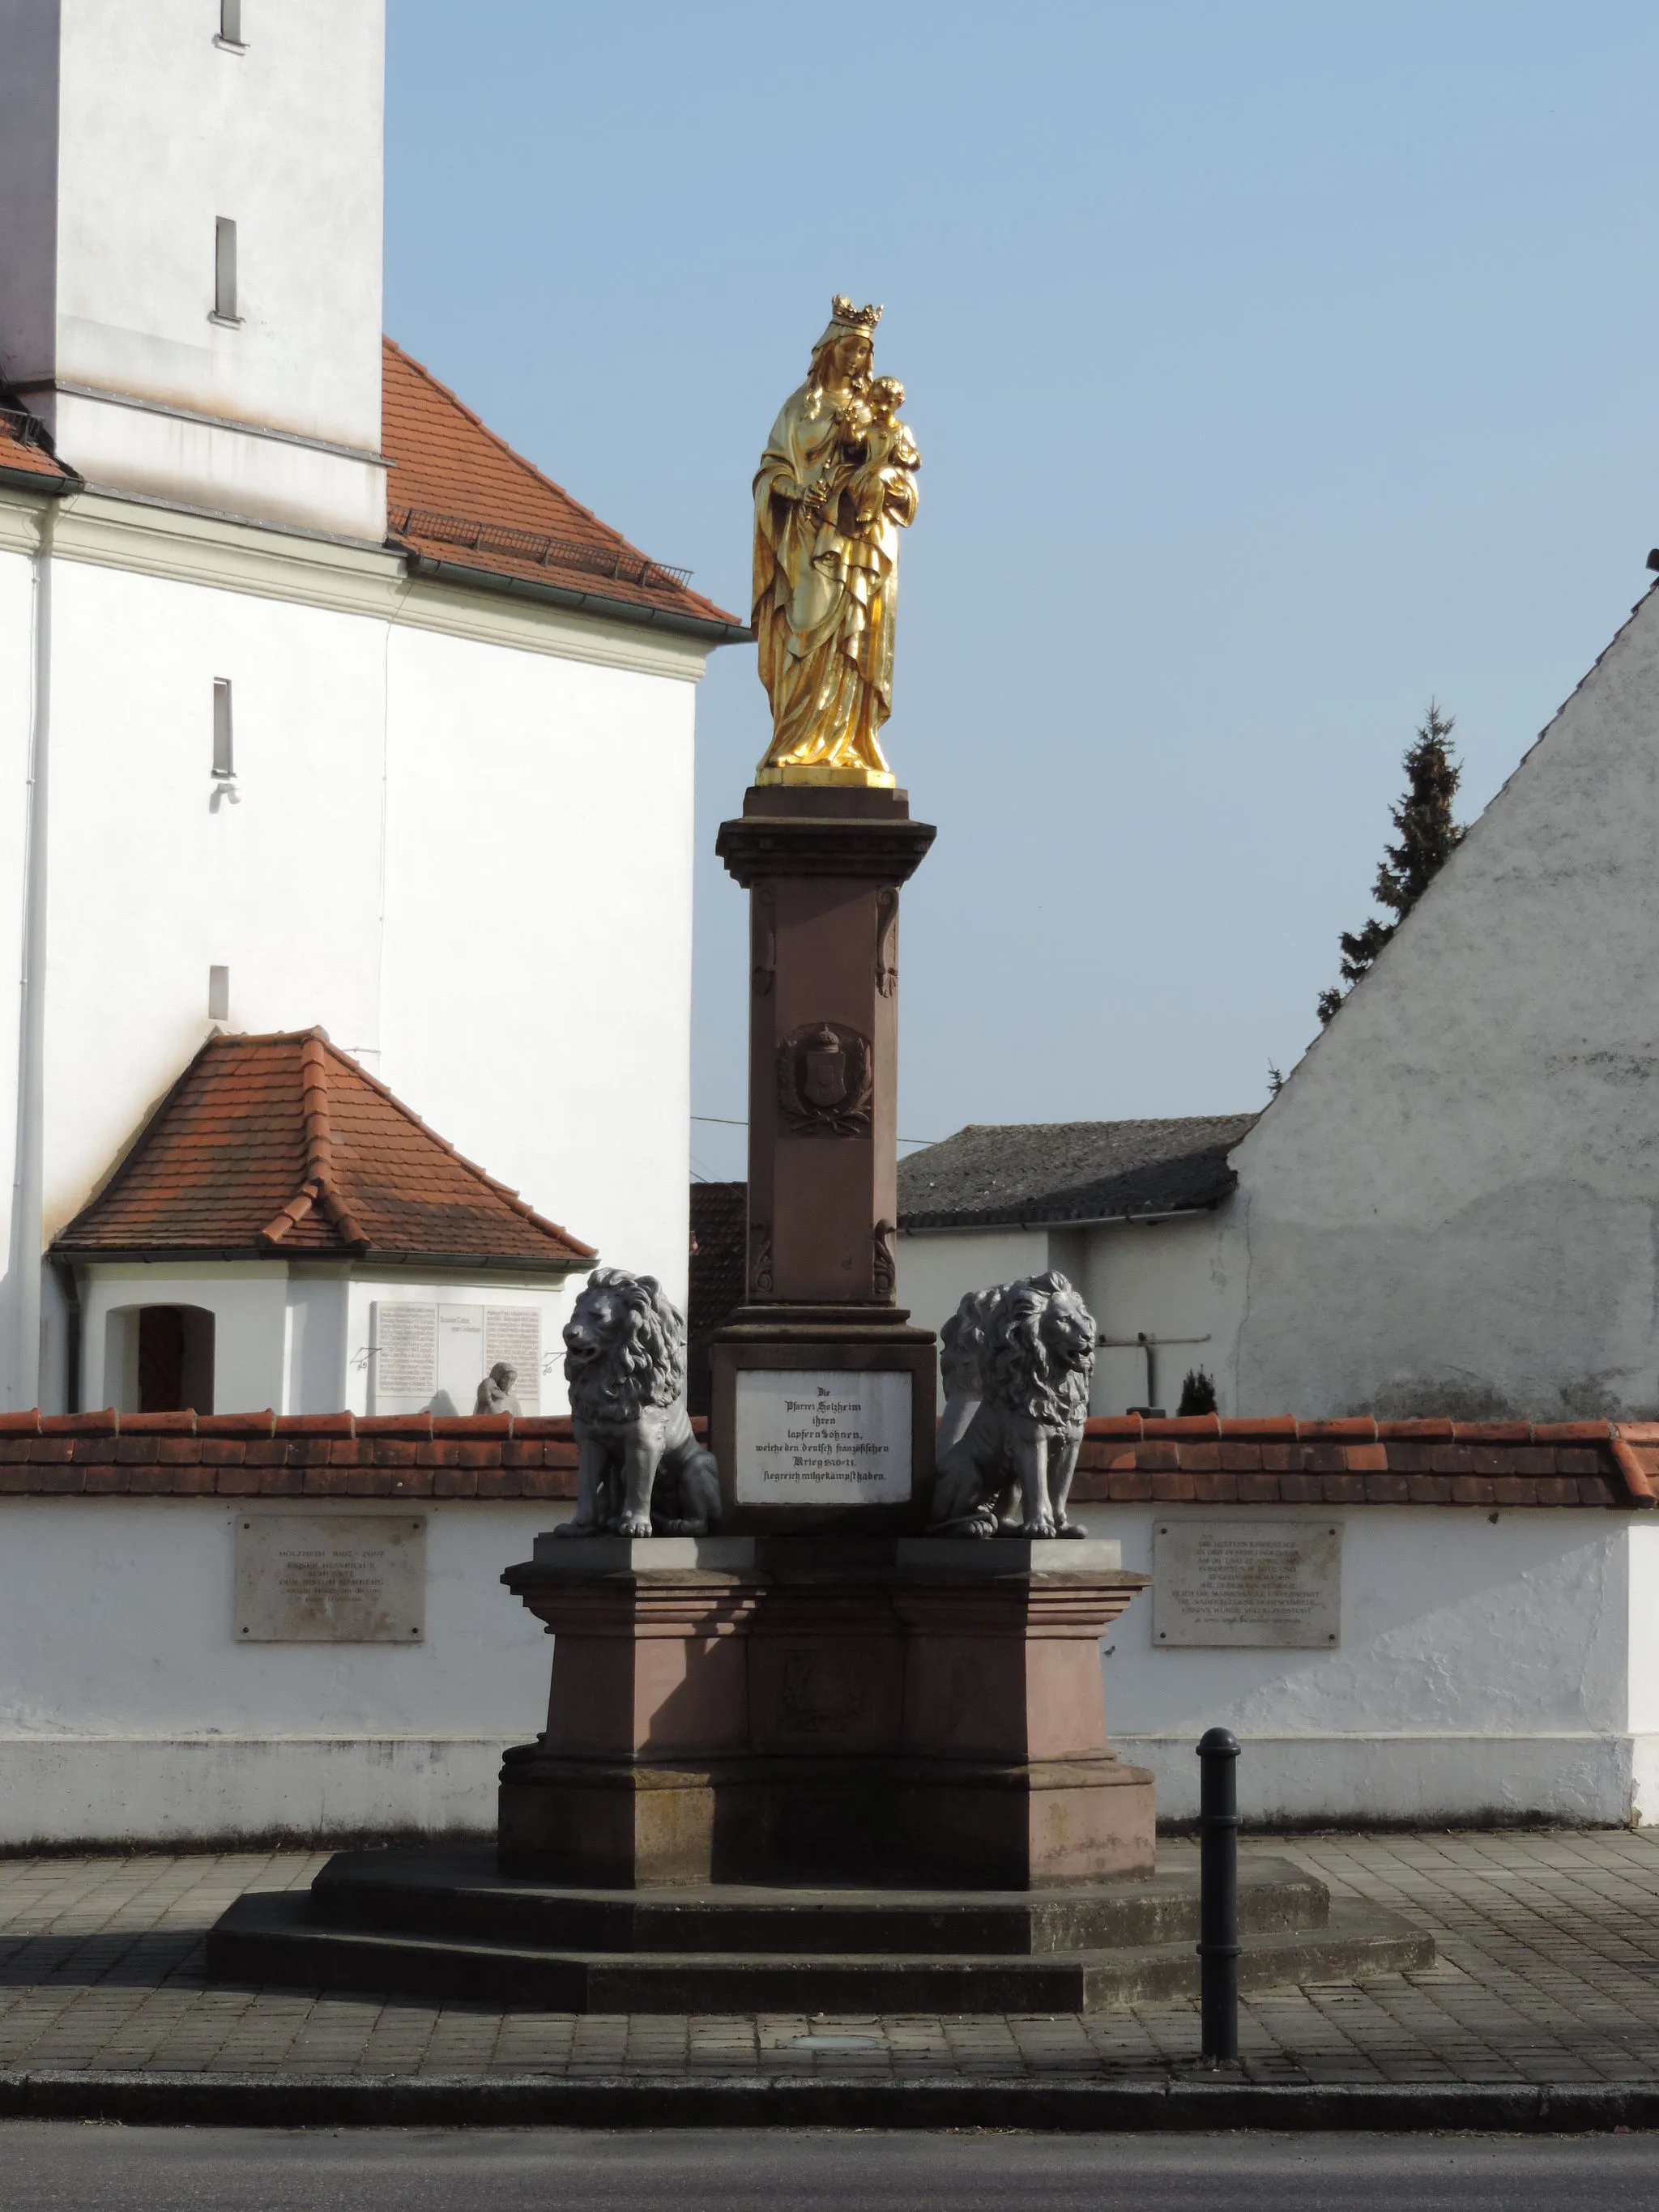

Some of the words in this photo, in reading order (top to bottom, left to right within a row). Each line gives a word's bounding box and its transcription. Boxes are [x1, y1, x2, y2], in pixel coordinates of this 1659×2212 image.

[817, 1386, 831, 1397] Die
[784, 1400, 816, 1413] Pfarrei
[817, 1400, 862, 1413] Holzheim
[812, 1415, 836, 1427] ihren
[787, 1428, 821, 1441] tapfern
[755, 1443, 783, 1455] welche
[784, 1442, 799, 1452] den
[791, 1455, 823, 1468] Krieg
[857, 1470, 887, 1483] haben.
